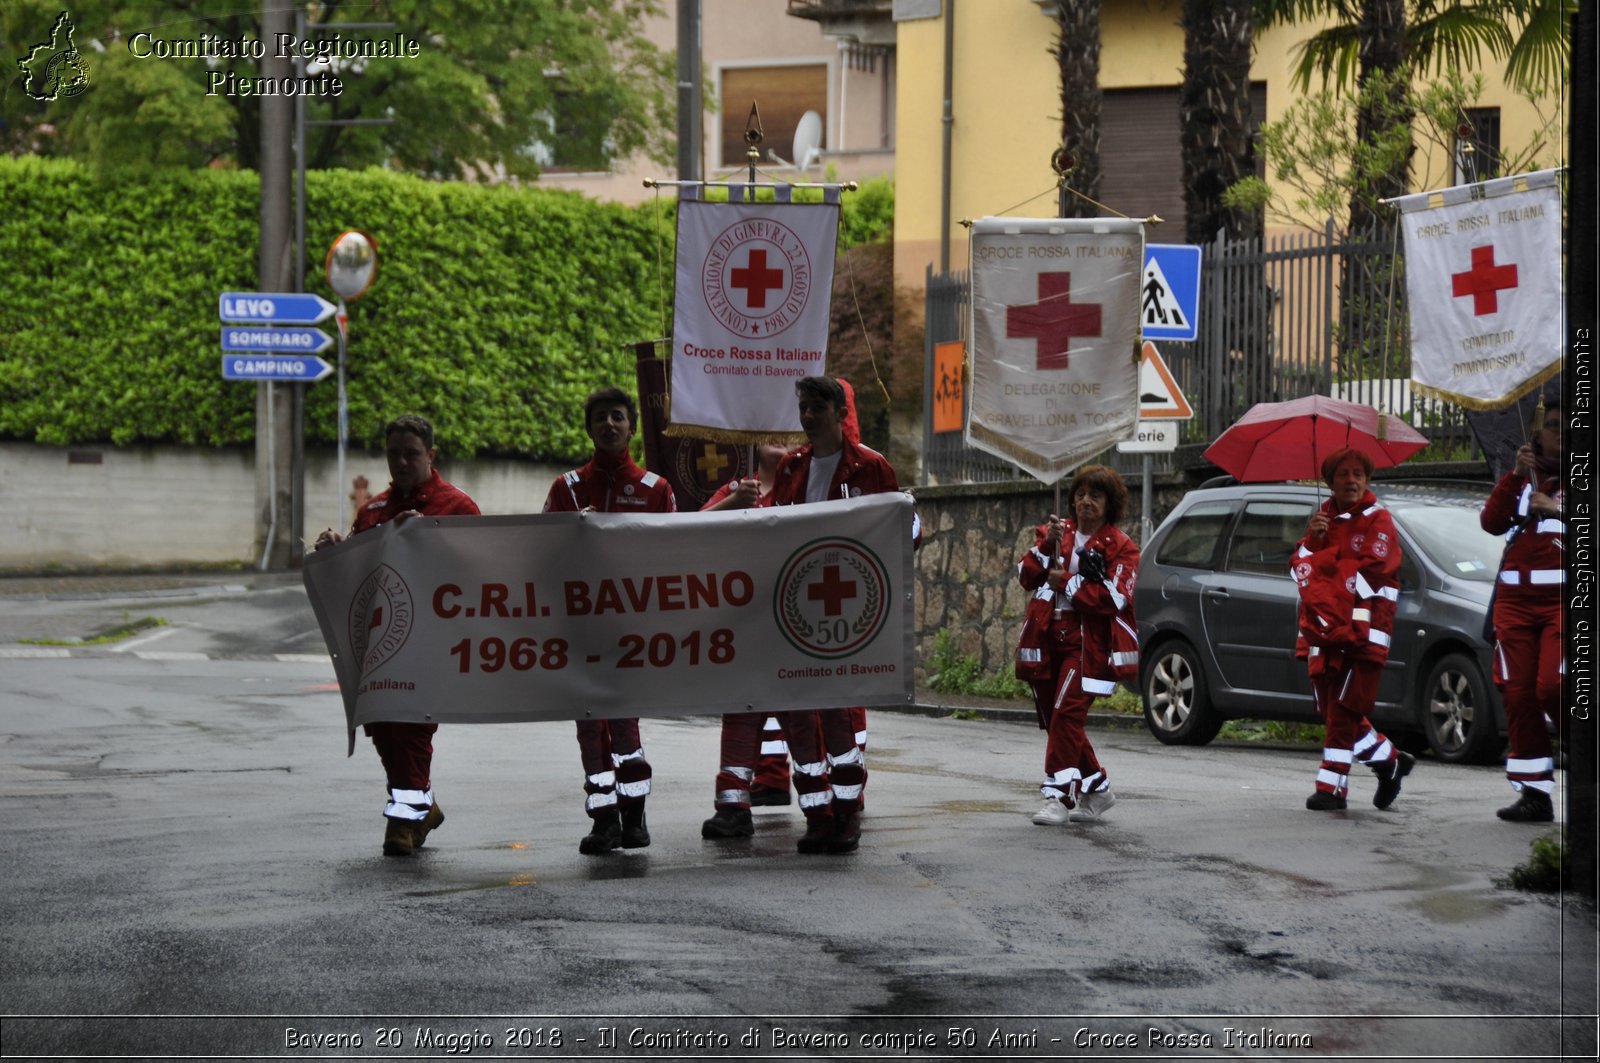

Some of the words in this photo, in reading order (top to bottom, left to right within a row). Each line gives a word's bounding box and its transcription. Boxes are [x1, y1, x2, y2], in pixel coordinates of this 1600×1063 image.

[1417, 222, 1451, 239] CROCE
[1456, 214, 1490, 232] ROSSA
[1497, 204, 1545, 224] ITALIANA
[720, 234, 735, 252] DI
[734, 222, 786, 246] GINEVRA
[786, 242, 802, 261] 22
[980, 246, 1023, 259] CROCE
[1028, 246, 1070, 259] ROSSA
[1076, 246, 1134, 259] ITALIANA
[705, 253, 748, 333] CONVENZIONE
[788, 264, 808, 314] AGOSTO
[224, 299, 276, 318] LEVO
[764, 311, 789, 333] 1864
[229, 332, 314, 348] SOMERARO
[1462, 329, 1514, 352] COMITATO
[684, 344, 725, 358] Croce
[730, 346, 771, 360] Rossa
[234, 360, 306, 375] CAMPINO
[703, 364, 750, 376] Comitato
[752, 366, 762, 376] di
[765, 366, 806, 377] Baveno
[1004, 383, 1101, 396] DELEGAZIONE
[1046, 398, 1058, 410] DI
[985, 412, 1078, 428] GRAVELLONA
[1138, 429, 1165, 442] erie
[388, 582, 404, 598] 22
[431, 582, 550, 619] C.R.I.
[563, 570, 754, 616] BAVENO
[382, 600, 408, 652] AGOSTO
[816, 618, 849, 645] 50
[450, 636, 570, 674] 1968
[586, 654, 601, 664] -
[616, 628, 736, 669] 2018
[778, 668, 832, 679] Comitato
[836, 665, 847, 676] di
[850, 663, 896, 675] Baveno
[370, 679, 416, 691] Italiana
